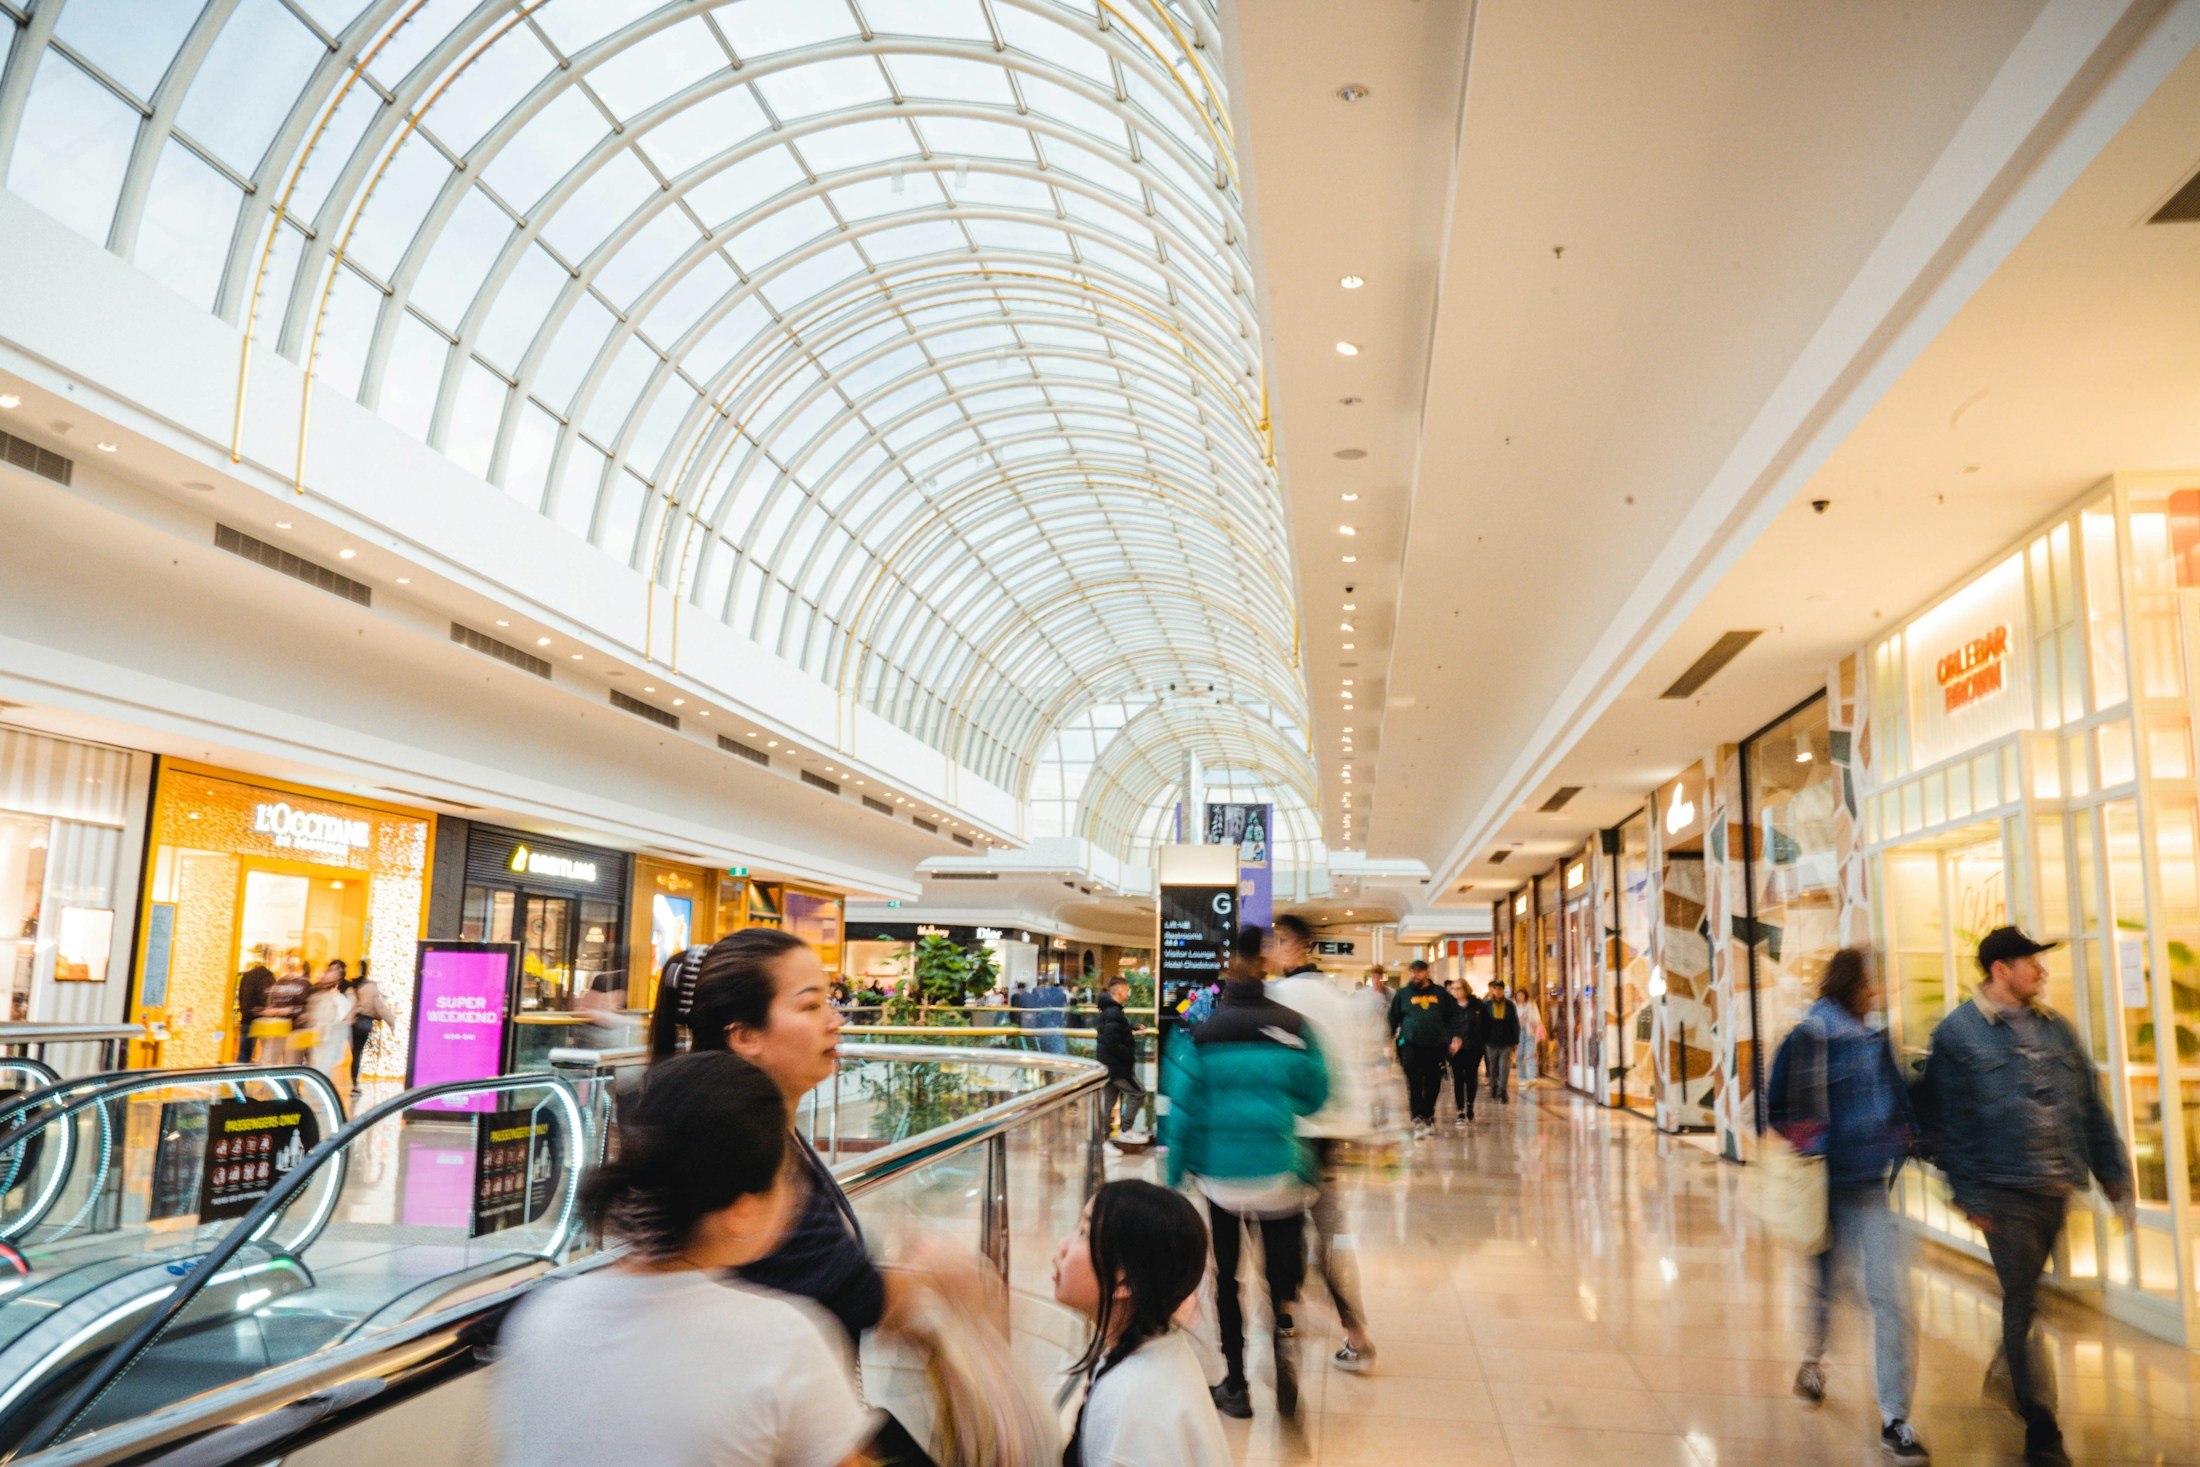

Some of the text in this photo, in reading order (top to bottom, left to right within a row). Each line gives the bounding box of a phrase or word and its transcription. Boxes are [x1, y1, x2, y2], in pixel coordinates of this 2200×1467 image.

[1212, 892, 1232, 915] G
[976, 927, 1003, 940] Dior
[1163, 950, 1216, 960] Visitor Lounge
[1163, 960, 1183, 969] Hotel
[436, 996, 487, 1009] SUPER
[426, 1010, 498, 1024] WEEKEND
